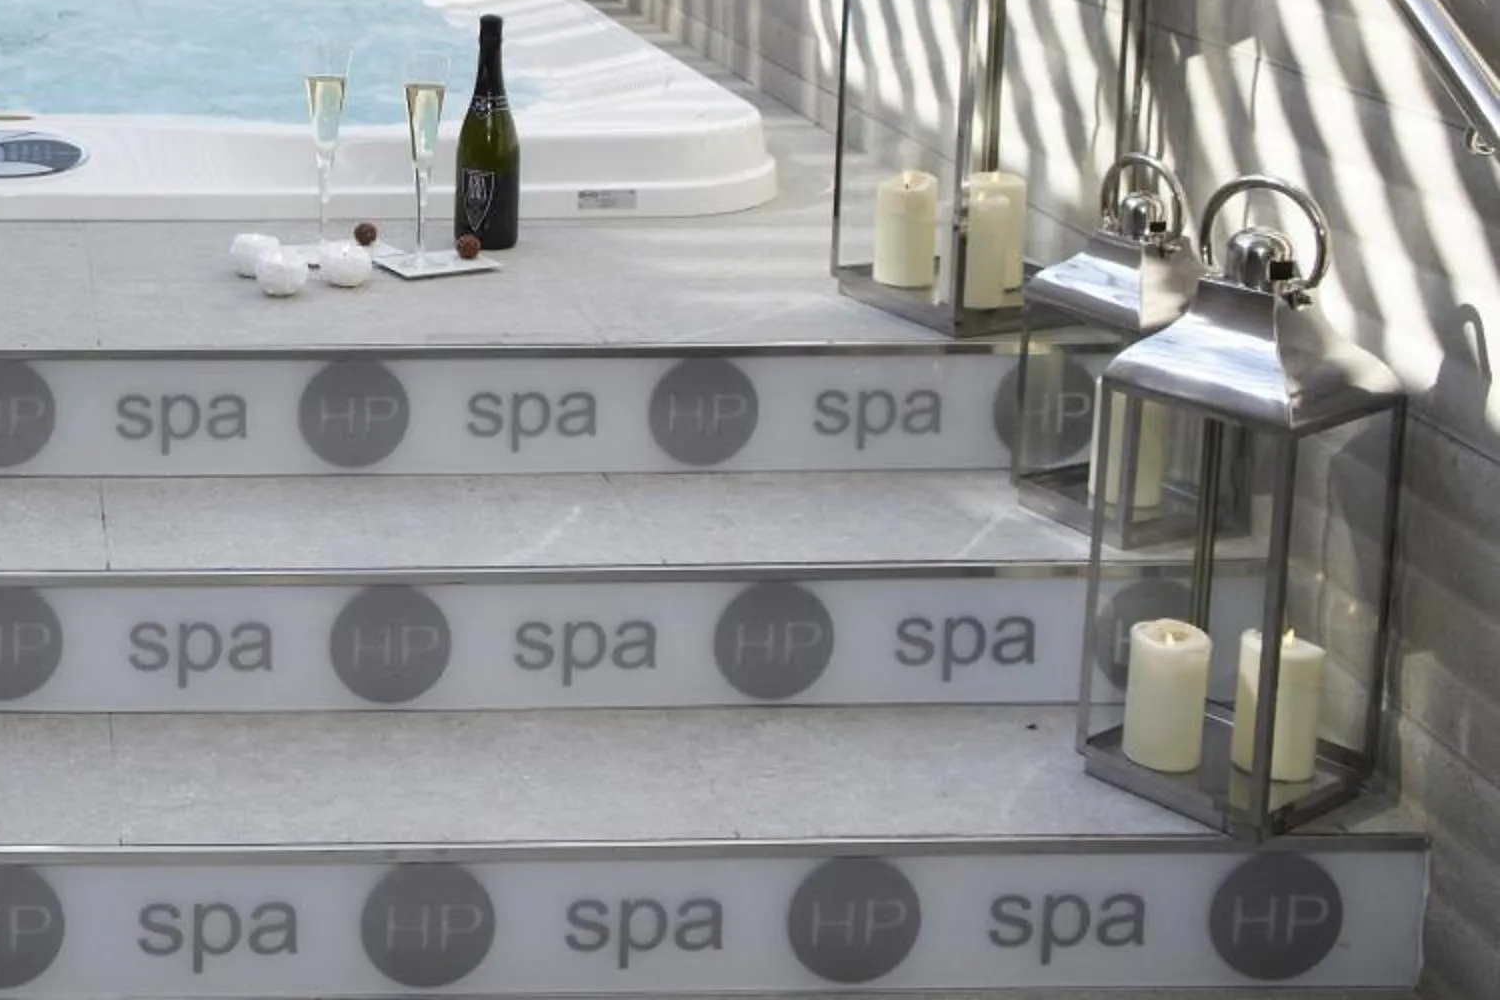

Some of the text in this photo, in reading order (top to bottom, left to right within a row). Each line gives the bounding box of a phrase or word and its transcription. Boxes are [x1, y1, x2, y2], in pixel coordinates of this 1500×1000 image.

[116, 394, 246, 455] spa
[320, 397, 399, 436] HP
[468, 392, 596, 452] spa
[669, 392, 747, 432] HP
[814, 389, 942, 450] spa
[129, 622, 272, 688] spa
[354, 625, 438, 669] HP
[515, 620, 656, 686] spa
[736, 620, 822, 666] HP
[896, 616, 1035, 682] spa
[139, 902, 297, 973] spa
[386, 905, 481, 951] HP
[566, 898, 722, 969] spa
[811, 899, 906, 947] HP
[990, 894, 1145, 965] spa
[1232, 895, 1328, 944] HP
